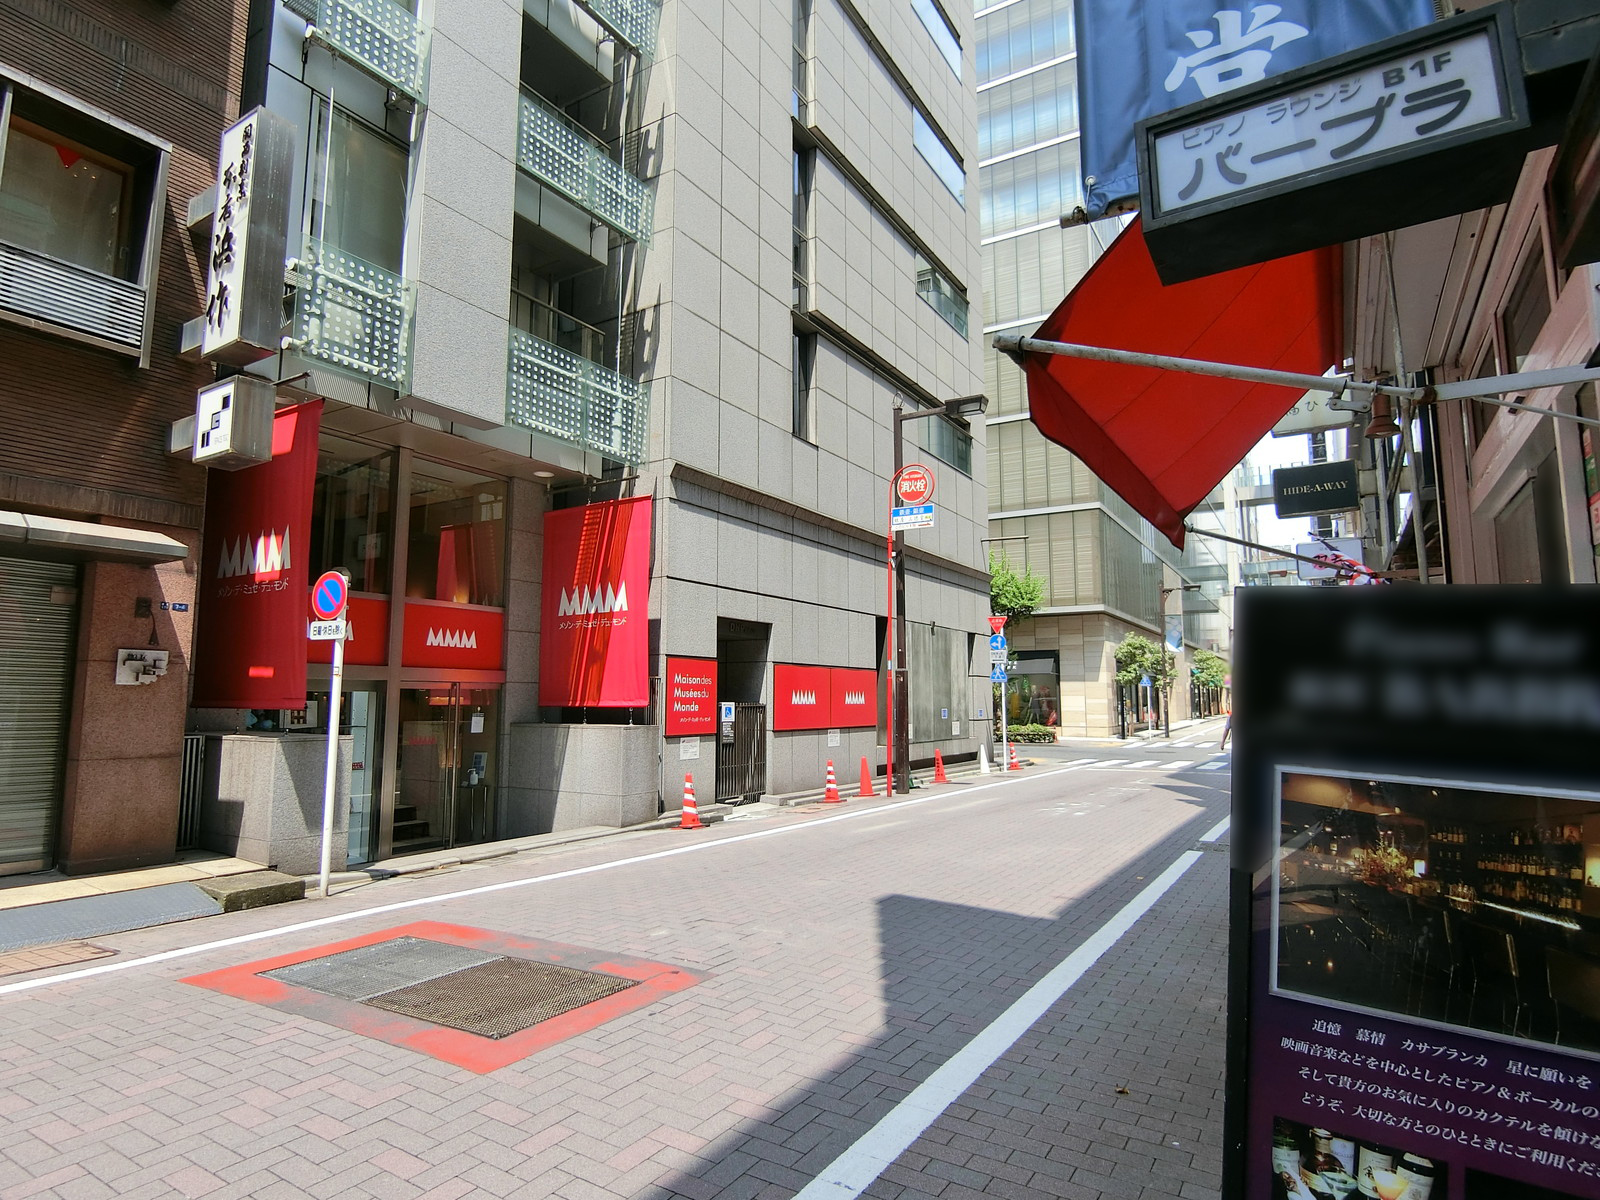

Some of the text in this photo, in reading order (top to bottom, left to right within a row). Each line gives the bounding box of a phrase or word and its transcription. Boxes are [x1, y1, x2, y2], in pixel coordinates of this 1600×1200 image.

[1383, 52, 1452, 89] B1F
[1182, 79, 1363, 150] ピアノ ラウンジ
[1178, 78, 1472, 201] バーブラ
[1282, 480, 1349, 496] HIDE-A-WAY
[217, 523, 291, 578] MMM
[558, 579, 628, 616] MMM
[426, 626, 477, 649] MMM
[673, 701, 699, 712] Monde
[791, 689, 816, 705] MMM
[845, 690, 865, 705] MMM
[1312, 1018, 1592, 1090] 追憶 慕情 カサブランカ 星に願いを
